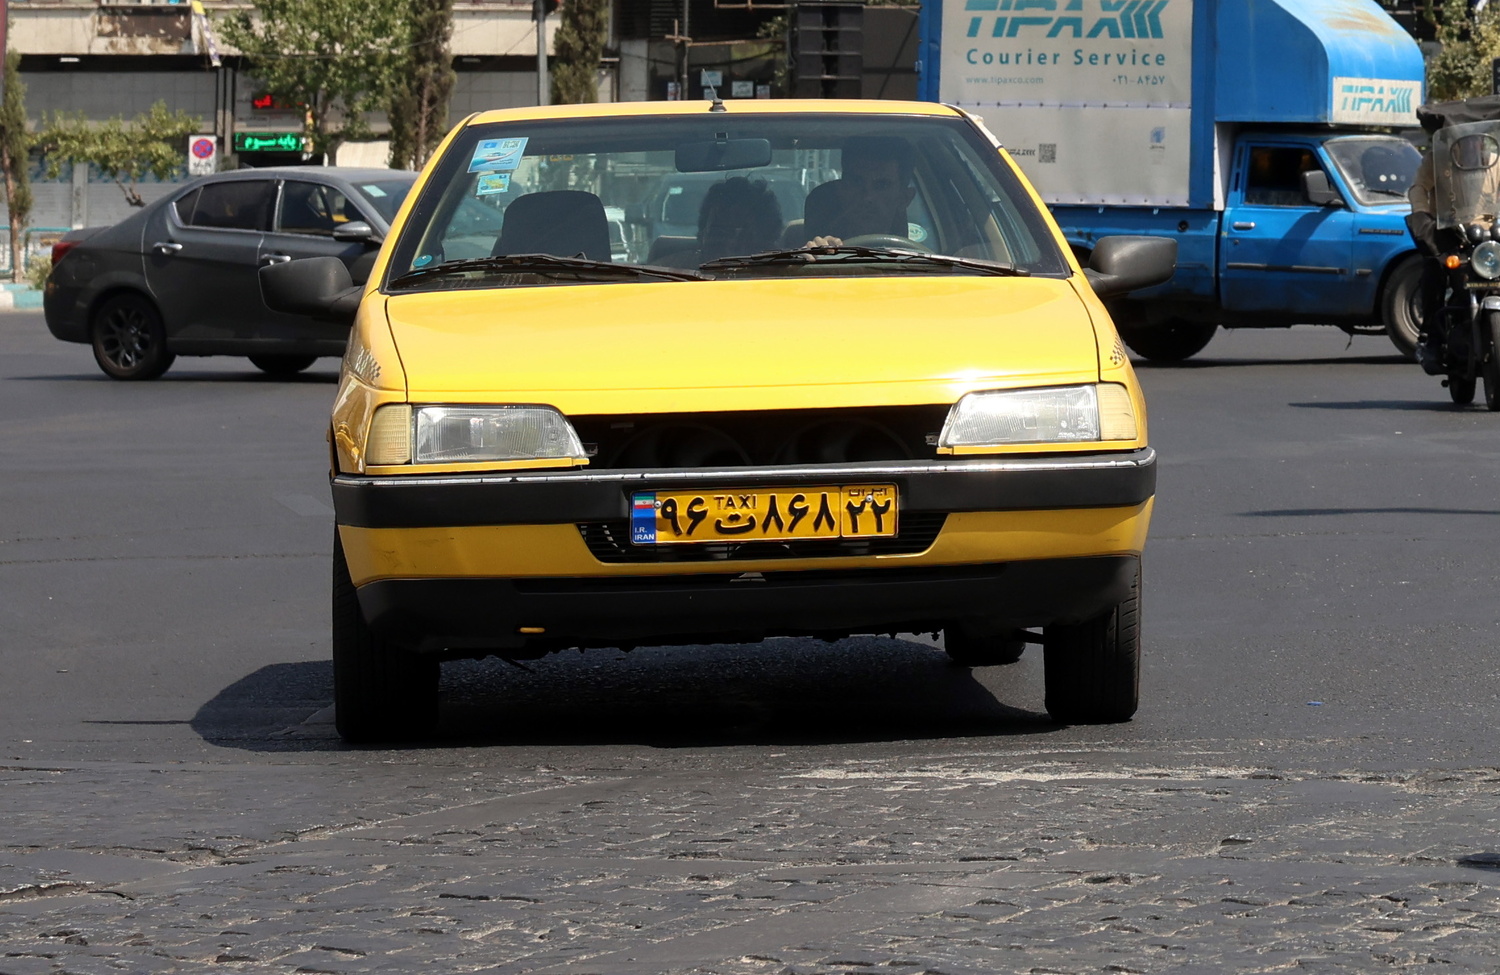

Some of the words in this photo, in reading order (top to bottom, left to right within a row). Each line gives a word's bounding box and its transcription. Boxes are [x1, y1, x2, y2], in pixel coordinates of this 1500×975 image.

[966, 48, 1061, 65] Courier
[1073, 48, 1166, 66] Service
[965, 75, 1044, 85] www.tipaxco.com
[1341, 84, 1413, 113] TIPAX
[713, 494, 758, 510] TAXI
